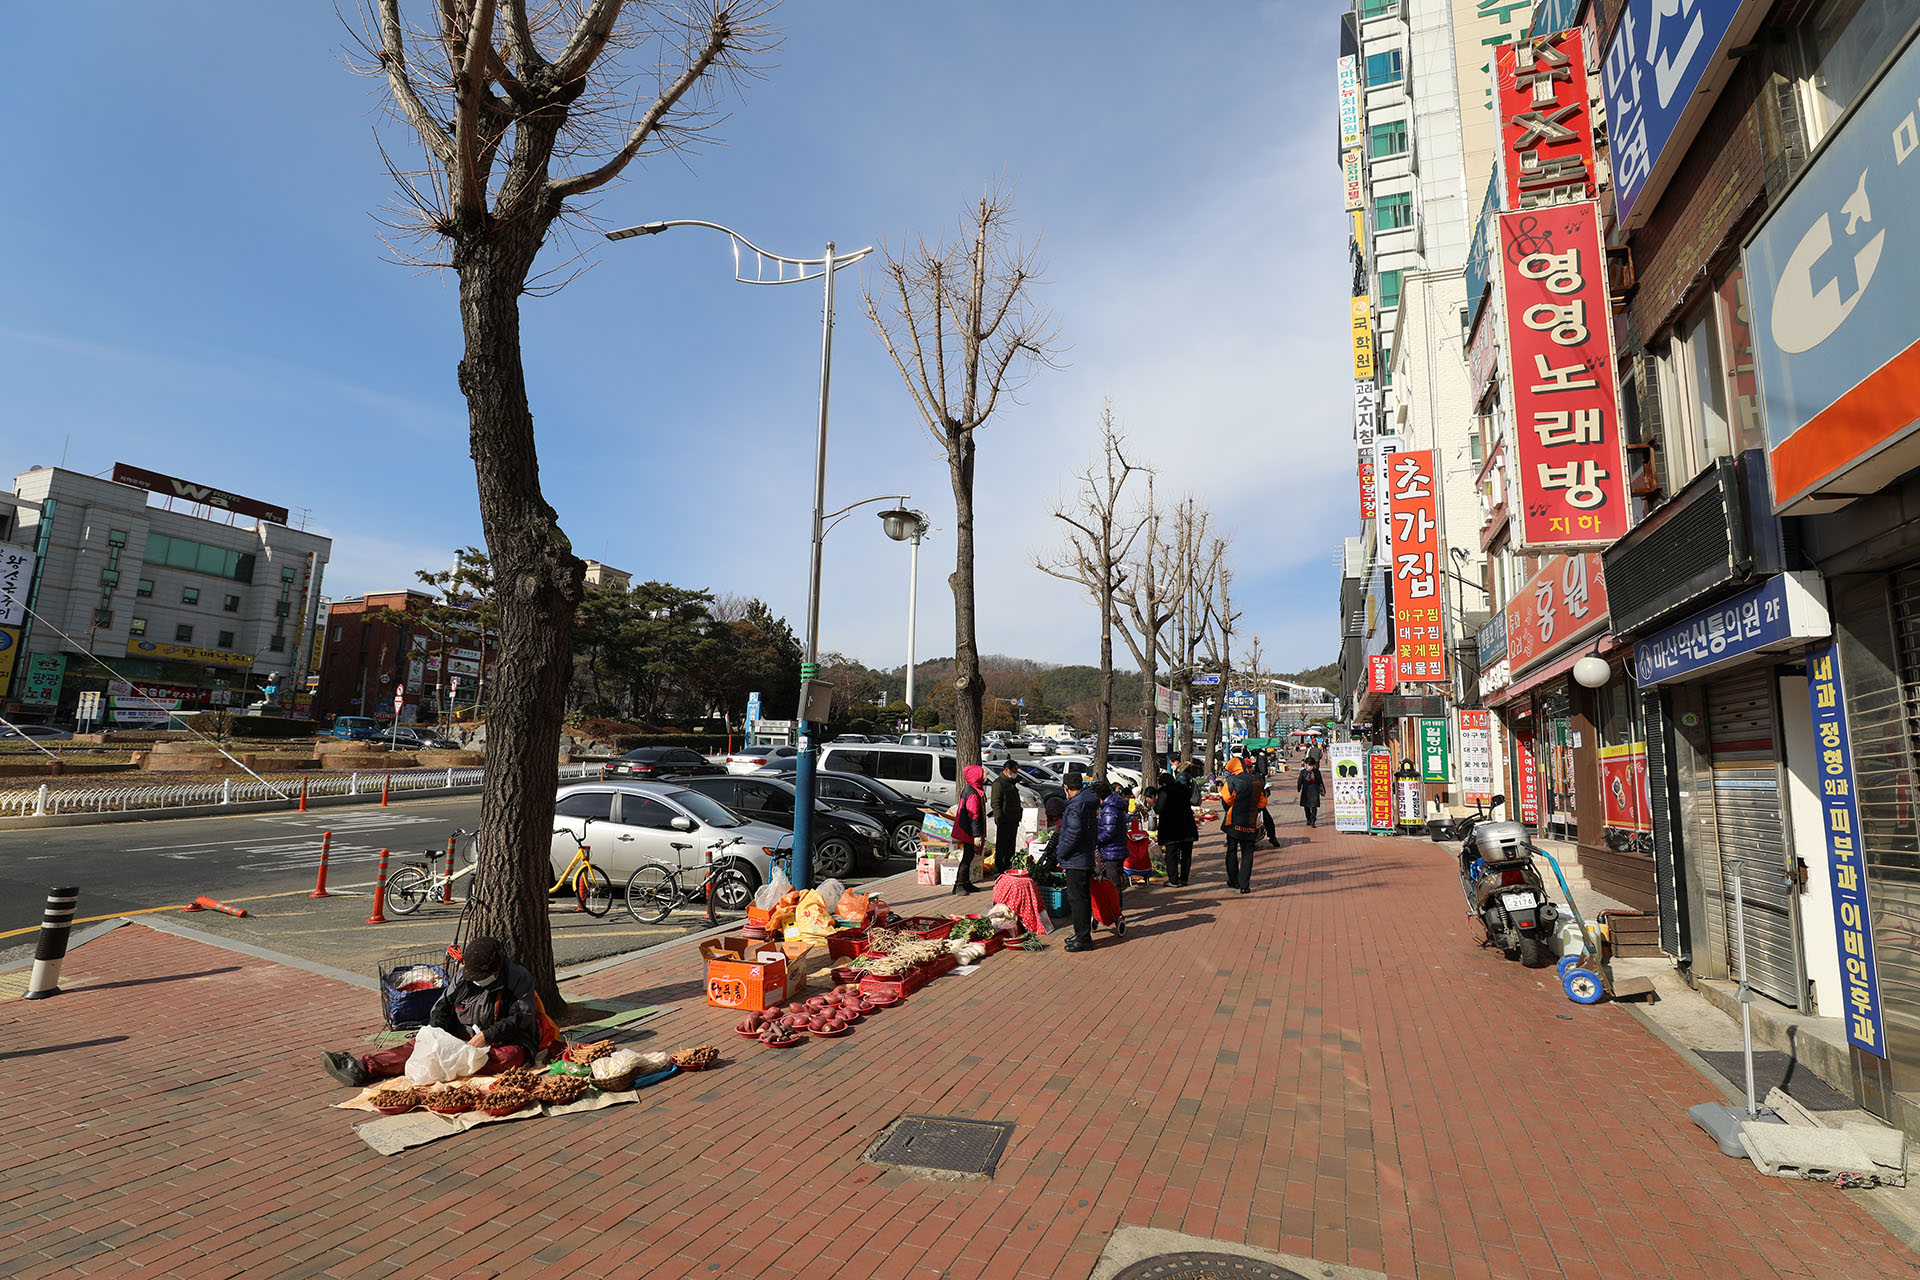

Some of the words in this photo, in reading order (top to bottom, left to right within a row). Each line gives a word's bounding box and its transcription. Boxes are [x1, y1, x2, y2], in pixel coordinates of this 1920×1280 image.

[1353, 317, 1371, 370] 국학원
[1356, 384, 1373, 395] 고려
[1518, 248, 1608, 508] 영영노래방
[1357, 395, 1375, 446] 수지침
[1394, 457, 1435, 599] 초가집
[1549, 514, 1602, 535] 지하
[1398, 608, 1439, 623] 아구찜
[1765, 597, 1780, 623] 2F
[1400, 625, 1440, 640] 대구찜
[1400, 643, 1441, 659] 꽃게찜
[1400, 661, 1442, 676] 해물찜
[1812, 655, 1836, 708] 내과
[1819, 721, 1849, 796] 정형외과
[1376, 819, 1390, 827] 2F
[1829, 808, 1858, 893] 피부과
[1840, 902, 1875, 1046] 이비인후과
